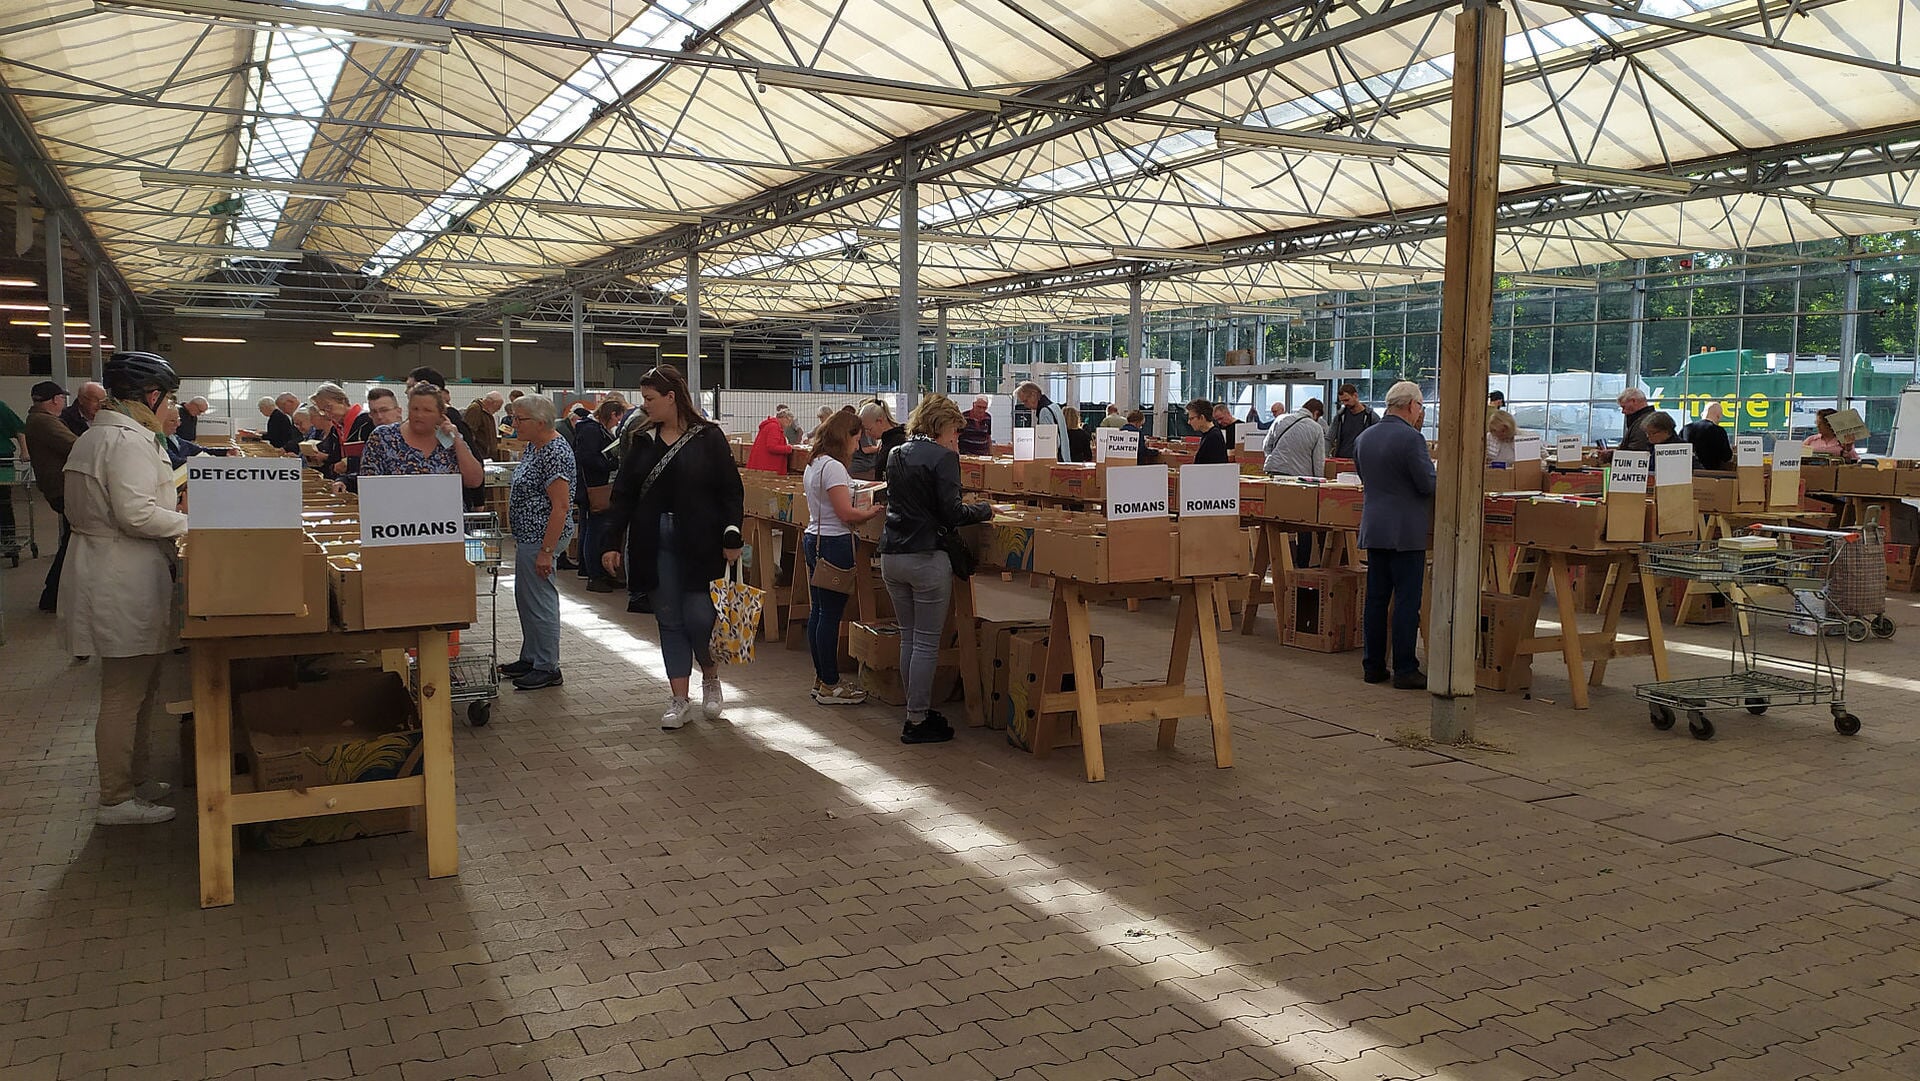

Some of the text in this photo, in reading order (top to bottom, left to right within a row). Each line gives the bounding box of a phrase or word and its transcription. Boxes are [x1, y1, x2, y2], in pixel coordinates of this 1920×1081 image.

[1109, 444, 1137, 452] PLANTEN
[1614, 459, 1648, 468] TUIN EN
[1780, 460, 1800, 468] HOBBY
[189, 468, 300, 481] DETECTIVES
[1611, 472, 1647, 482] PLANTEN
[1114, 501, 1165, 514] ROMANS
[1187, 499, 1236, 511] ROMANS
[371, 521, 458, 538] ROMANS
